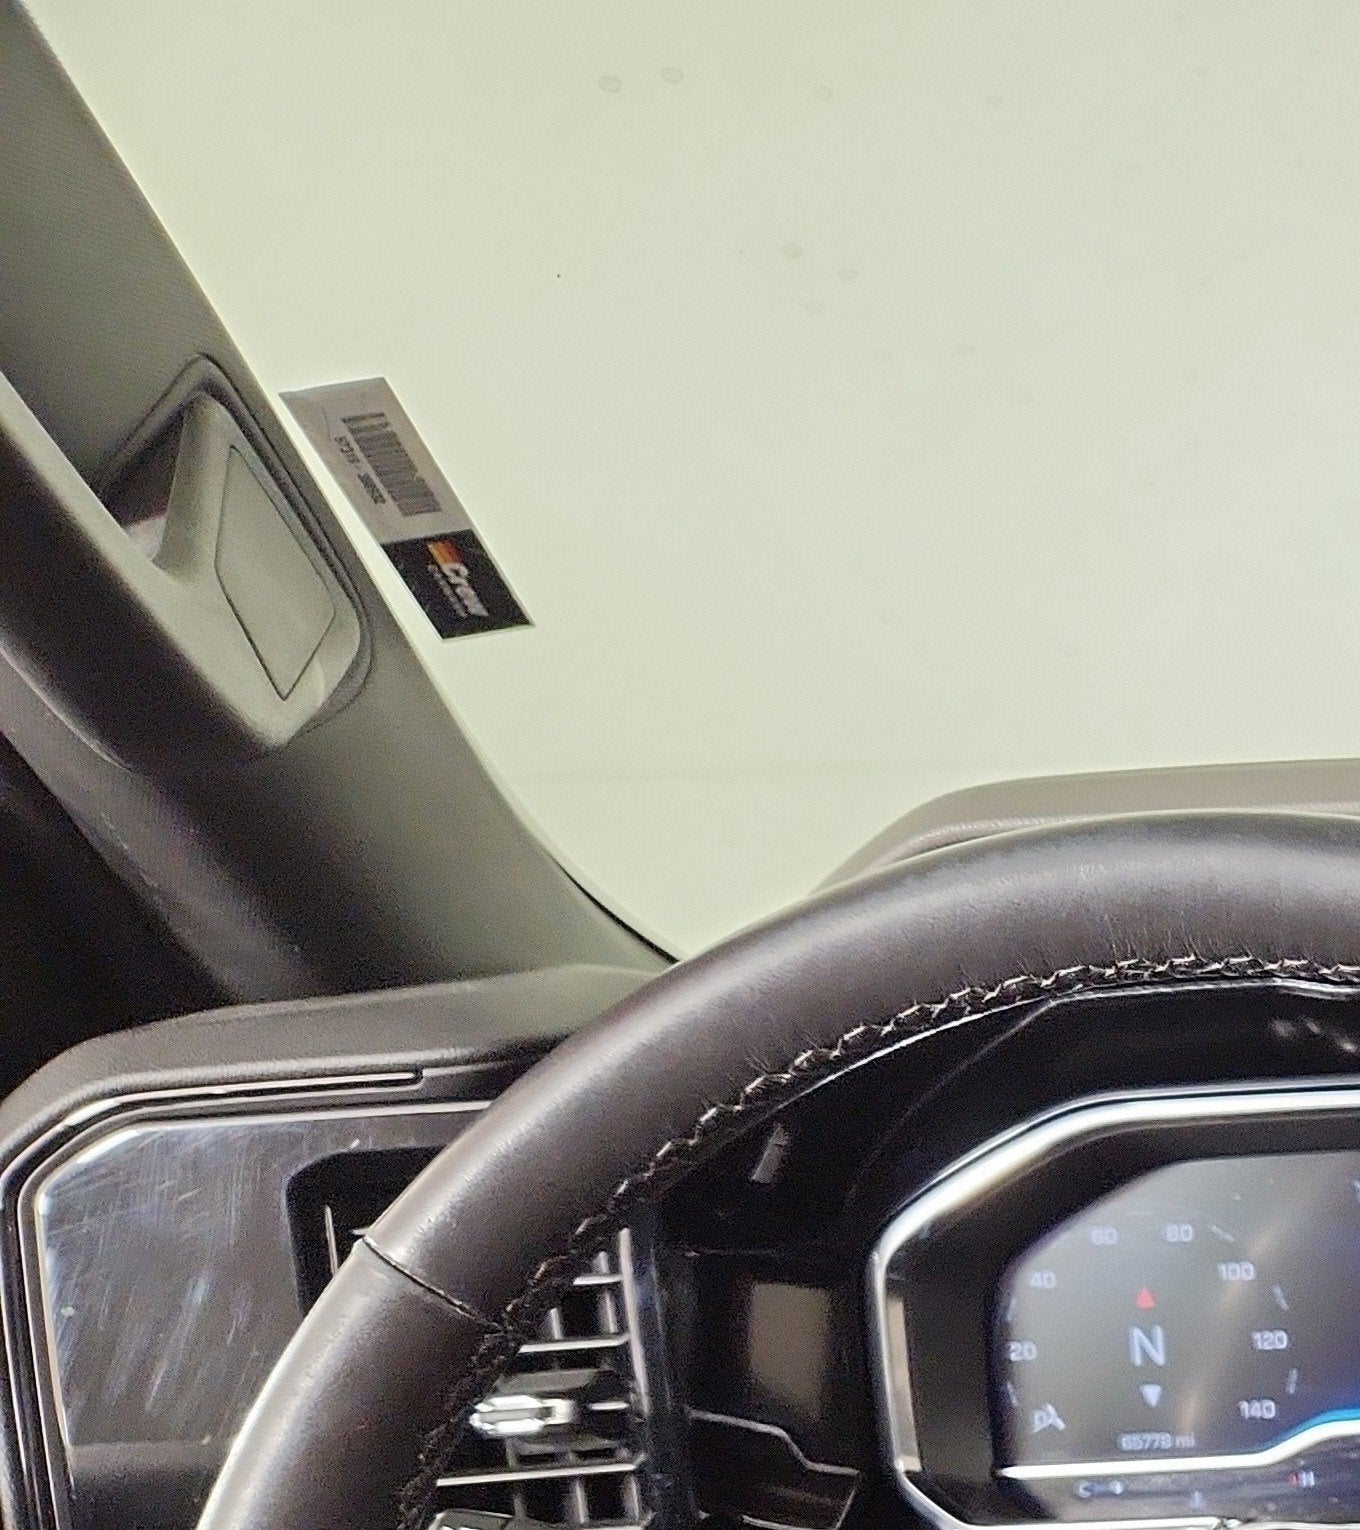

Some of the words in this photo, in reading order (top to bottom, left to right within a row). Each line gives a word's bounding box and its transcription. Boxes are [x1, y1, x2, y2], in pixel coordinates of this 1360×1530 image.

[1165, 1223, 1194, 1243] 80
[1028, 1269, 1057, 1290] 40
[1217, 1261, 1256, 1281] 100
[1009, 1340, 1038, 1361] 20
[1128, 1325, 1167, 1367] N
[1251, 1331, 1288, 1350] 120
[1239, 1400, 1276, 1420] 140
